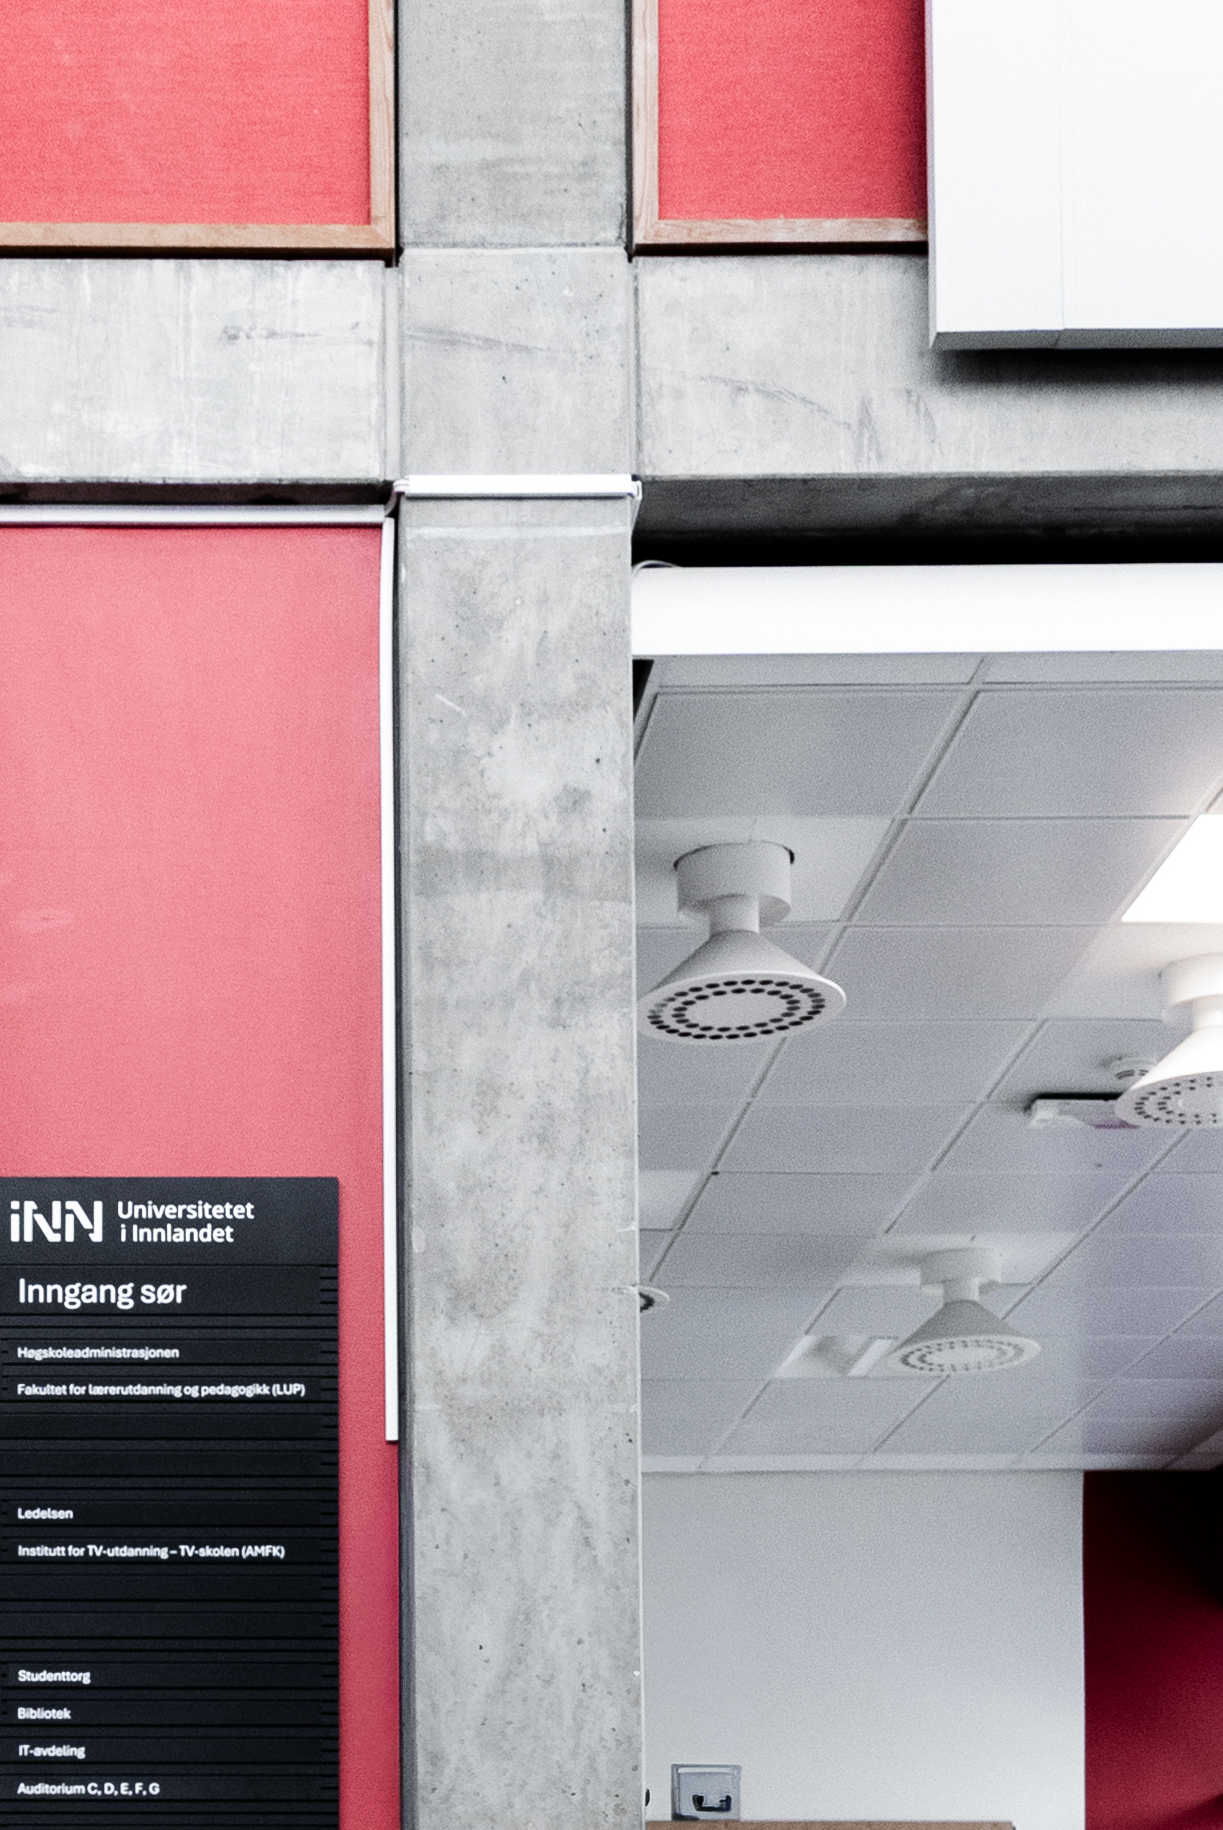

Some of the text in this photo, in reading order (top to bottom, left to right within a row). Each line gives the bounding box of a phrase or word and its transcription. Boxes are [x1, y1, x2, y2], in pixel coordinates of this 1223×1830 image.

[117, 1200, 255, 1219] Universitetet
[120, 1223, 234, 1243] i Innlandet
[19, 1278, 187, 1310] Inngang sør
[17, 1346, 180, 1361] Høgskoleadministrasjonen
[17, 1383, 306, 1398] Fakultet for lærerutdanning og pedagogikk (LUP)
[17, 1508, 73, 1519] Ledelsen
[18, 1545, 66, 1556] Institutt
[67, 1545, 86, 1557] for
[87, 1545, 169, 1559] TV-utdanning
[179, 1545, 239, 1557] TV-skolen
[241, 1545, 285, 1559] (AMFK)
[18, 1670, 91, 1684] Studenttorg
[17, 1707, 71, 1719] Bibliotek
[19, 1744, 86, 1759] IT-avdeling
[17, 1783, 86, 1795] Auditorium
[87, 1782, 102, 1796] C,
[104, 1782, 119, 1796] D,
[120, 1782, 133, 1796] E,
[148, 1782, 160, 1795] G
